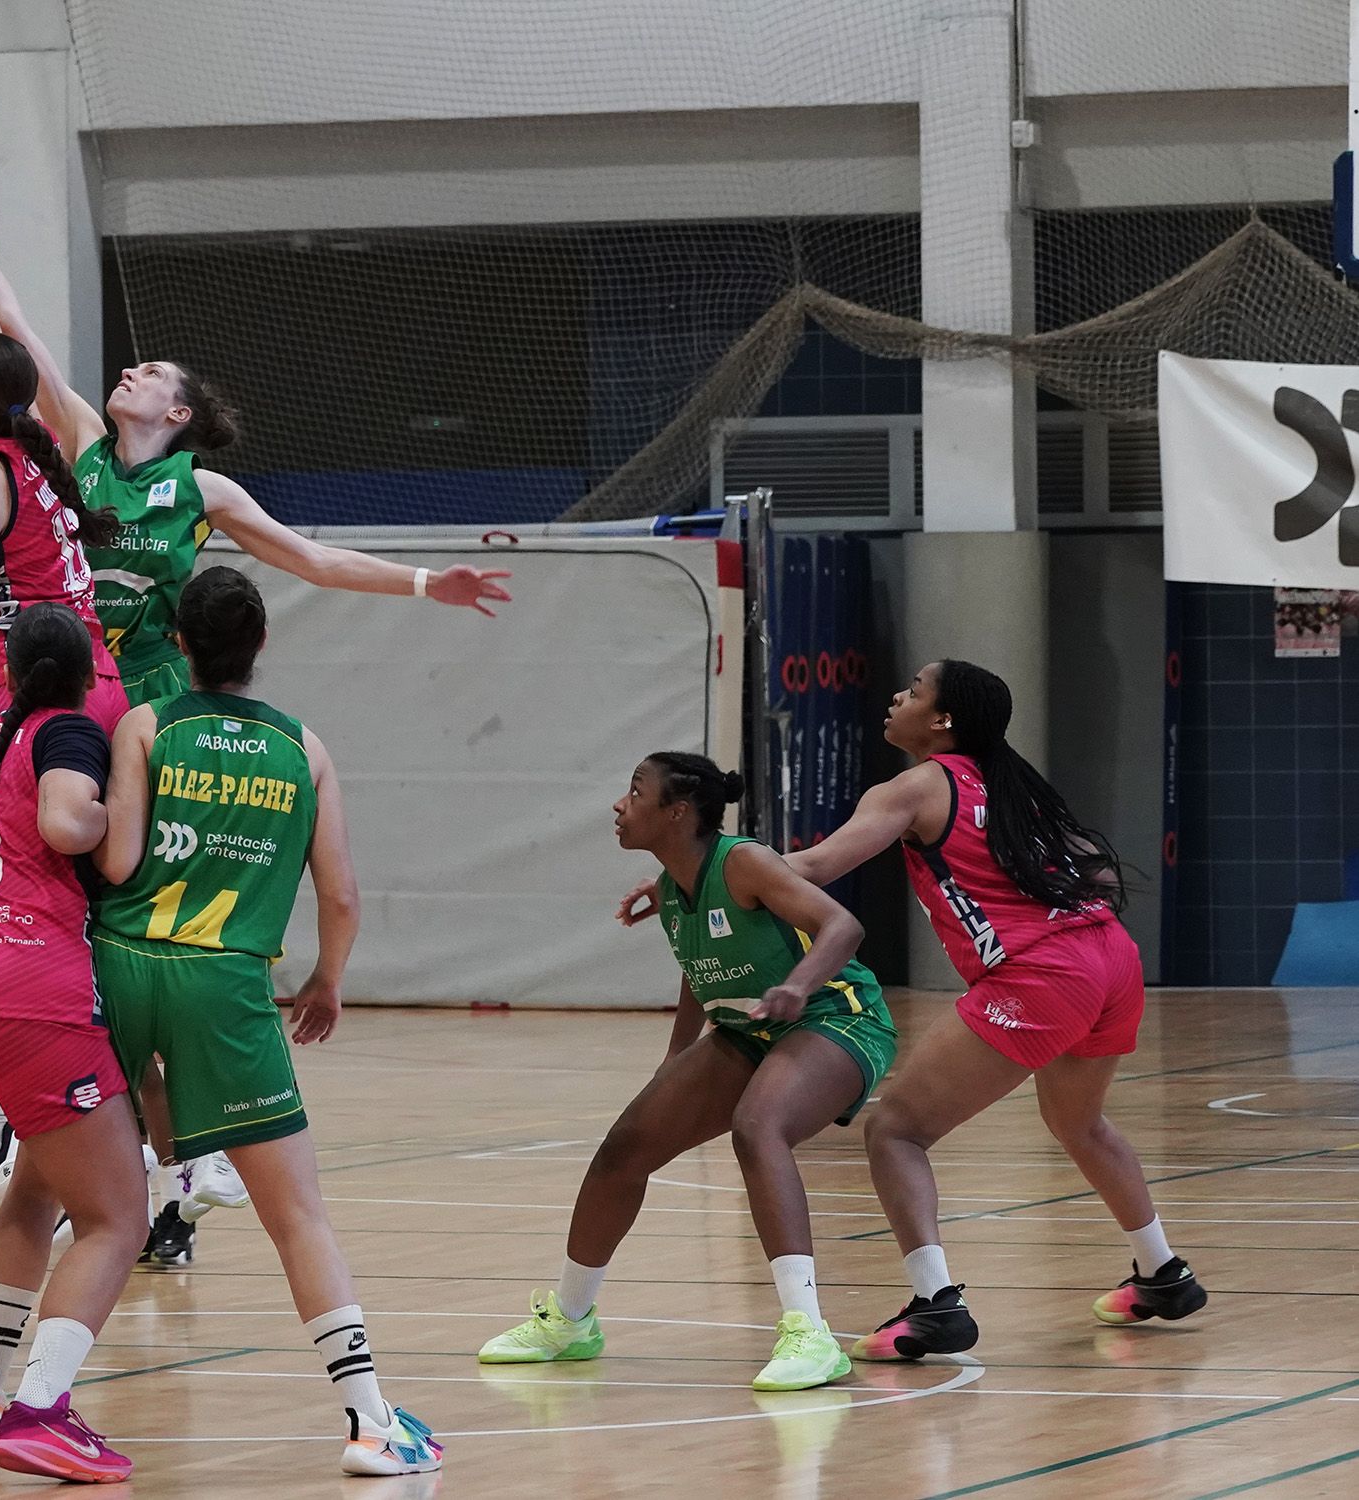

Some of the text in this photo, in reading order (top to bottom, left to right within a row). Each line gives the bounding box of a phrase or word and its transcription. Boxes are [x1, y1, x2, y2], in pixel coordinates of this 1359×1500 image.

[157, 761, 298, 814] DÍAZ-PACHE
[145, 880, 240, 949] 14
[4, 935, 46, 947] Fernando
[703, 963, 755, 984] GALICIA
[223, 1100, 250, 1114] Diario
